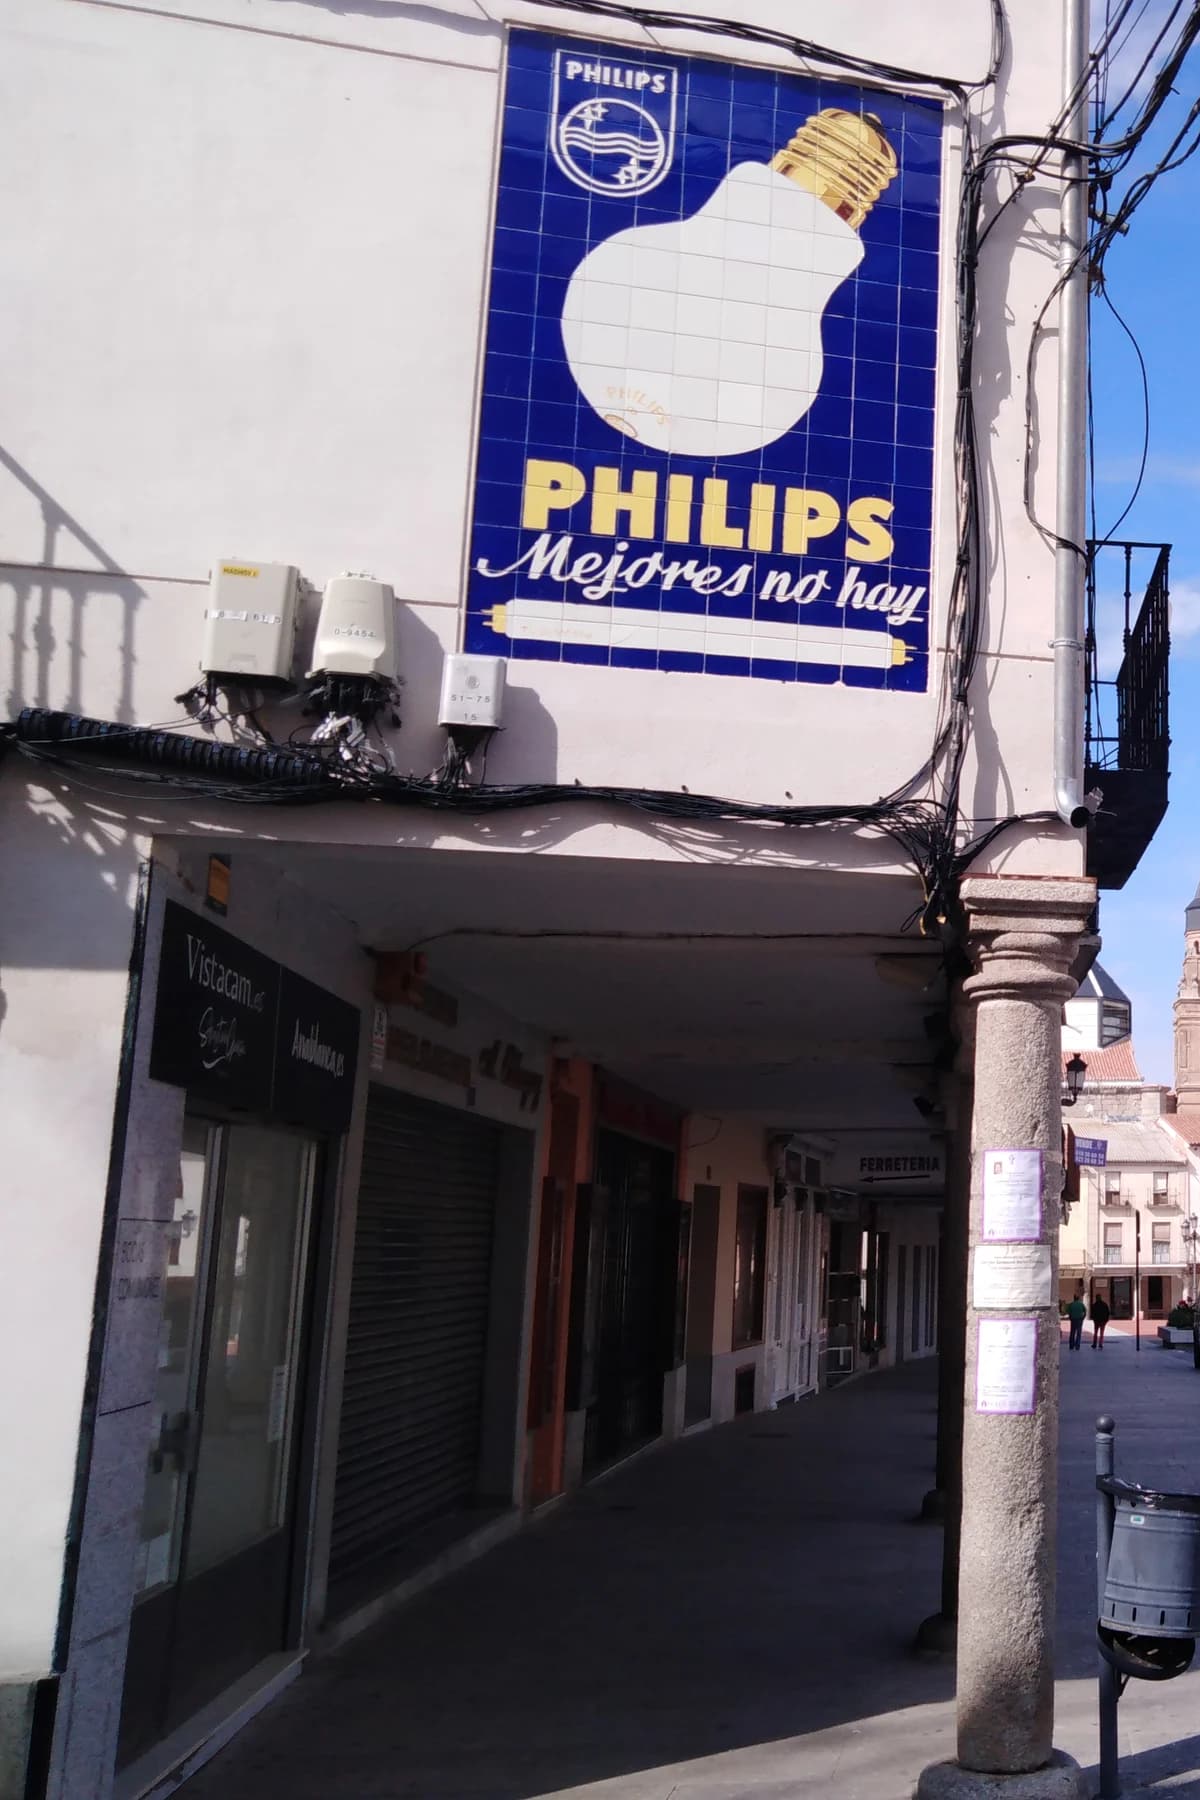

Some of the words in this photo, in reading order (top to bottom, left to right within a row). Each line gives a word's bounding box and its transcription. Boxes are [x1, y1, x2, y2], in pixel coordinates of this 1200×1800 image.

[565, 60, 666, 94] PHILIPS
[606, 385, 671, 427] PHILIPS
[521, 458, 895, 562] PHILIPS
[477, 533, 755, 599] Mejores
[760, 569, 830, 602] no
[835, 567, 926, 626] hay
[860, 1156, 940, 1172] FERRETERIA
